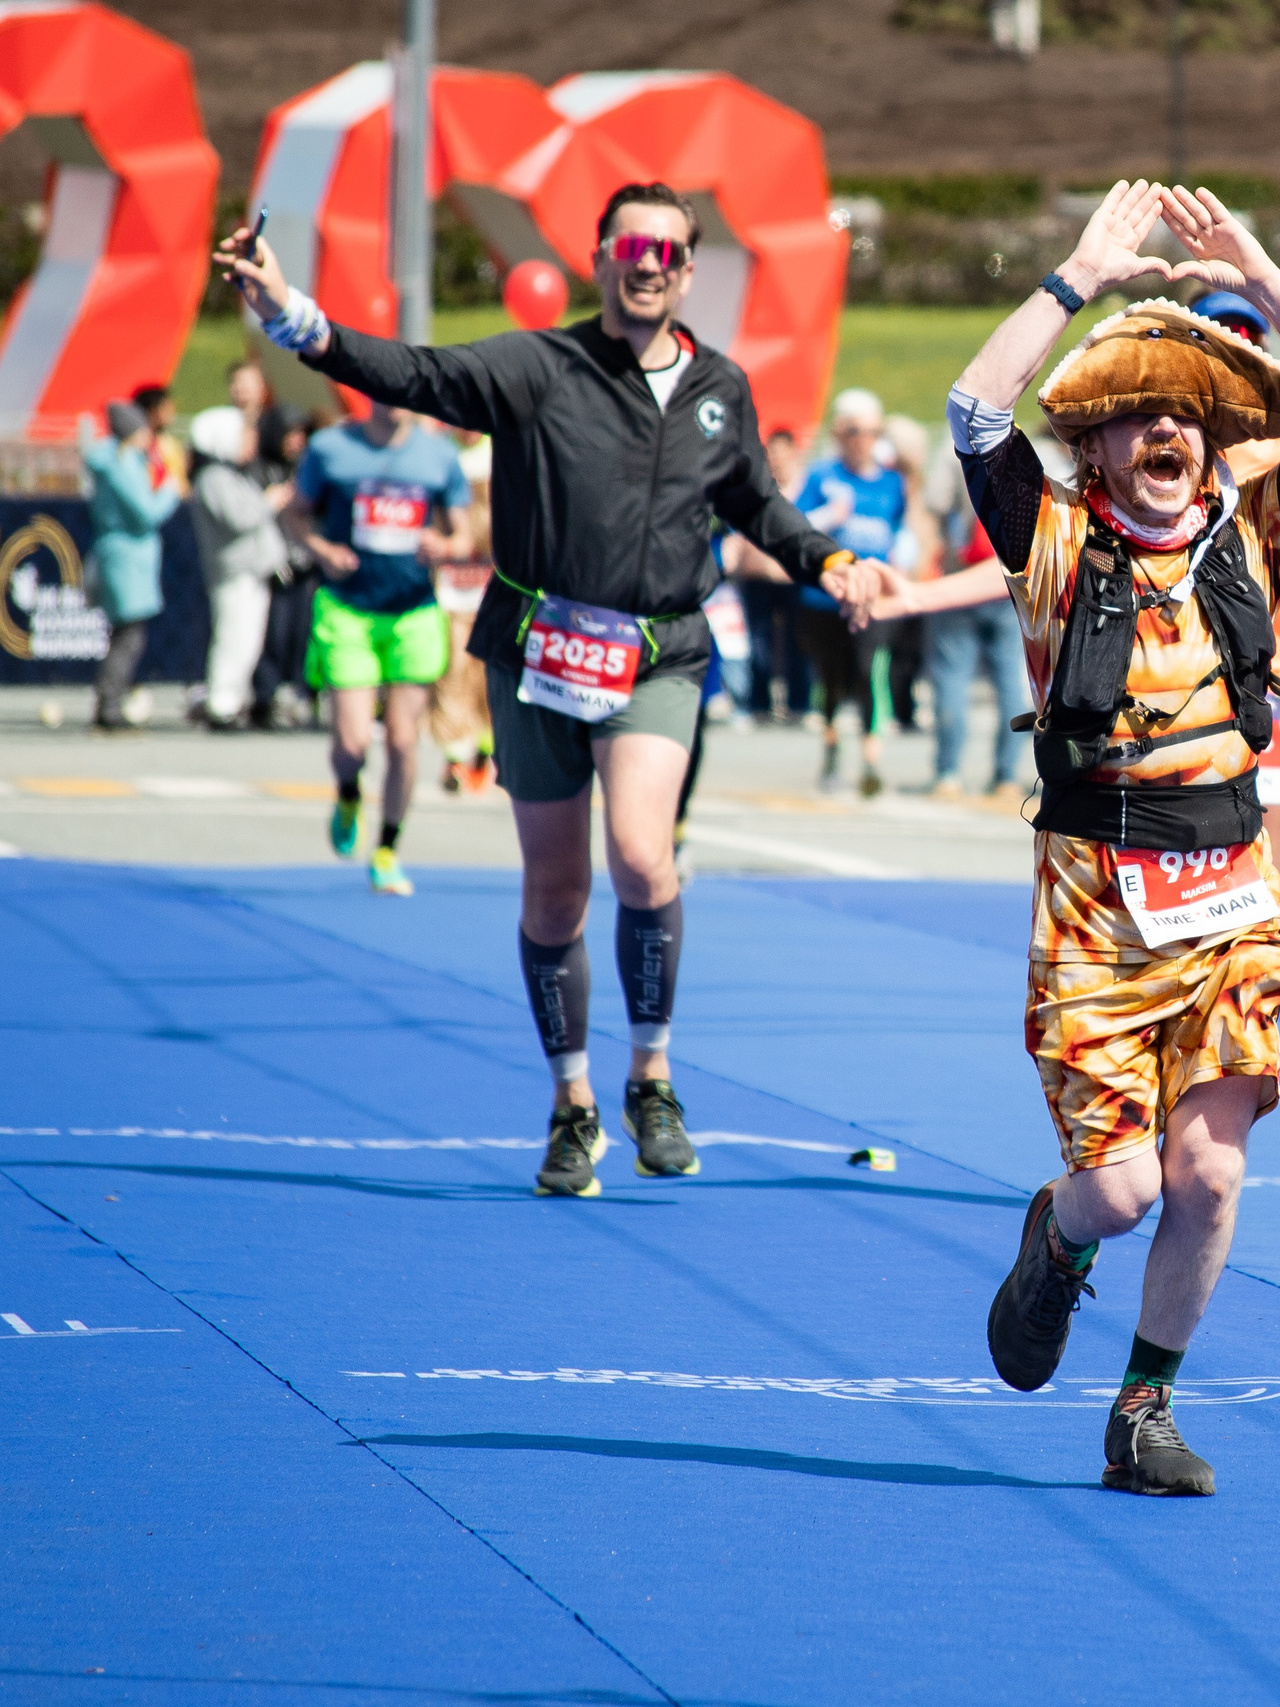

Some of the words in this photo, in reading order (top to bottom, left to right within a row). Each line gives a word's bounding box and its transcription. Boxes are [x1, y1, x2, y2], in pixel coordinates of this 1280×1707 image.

[544, 632, 627, 677] 2025
[1125, 875, 1138, 892] E
[1181, 880, 1217, 900] MAKSIM
